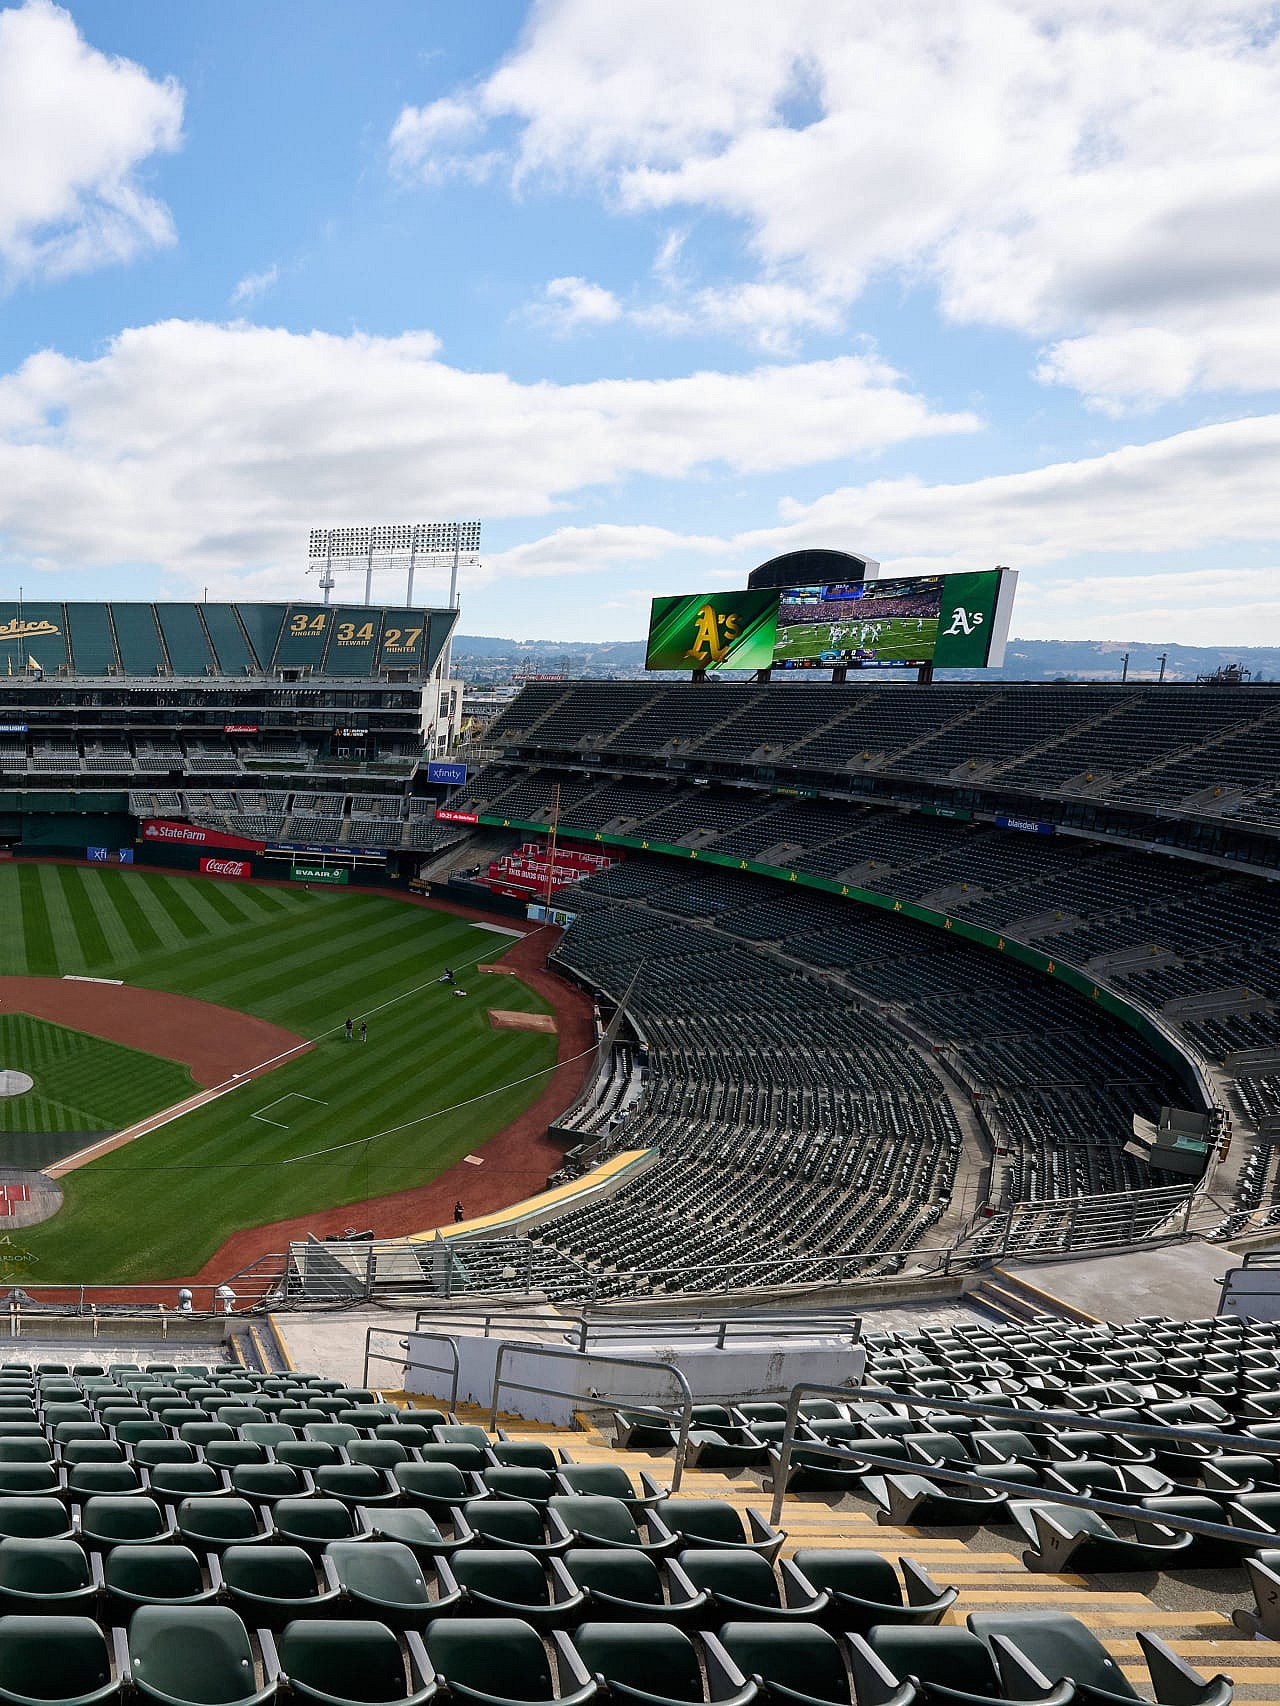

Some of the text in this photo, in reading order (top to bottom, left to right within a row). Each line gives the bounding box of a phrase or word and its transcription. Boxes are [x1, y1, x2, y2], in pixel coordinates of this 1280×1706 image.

[290, 614, 326, 631] 34
[942, 607, 984, 635] A's
[337, 622, 374, 641] 34
[383, 628, 423, 647] 27
[682, 604, 742, 661] A's
[433, 768, 461, 780] xfinity
[295, 869, 331, 878] EVA AIR
[1051, 1537, 1060, 1550] 11
